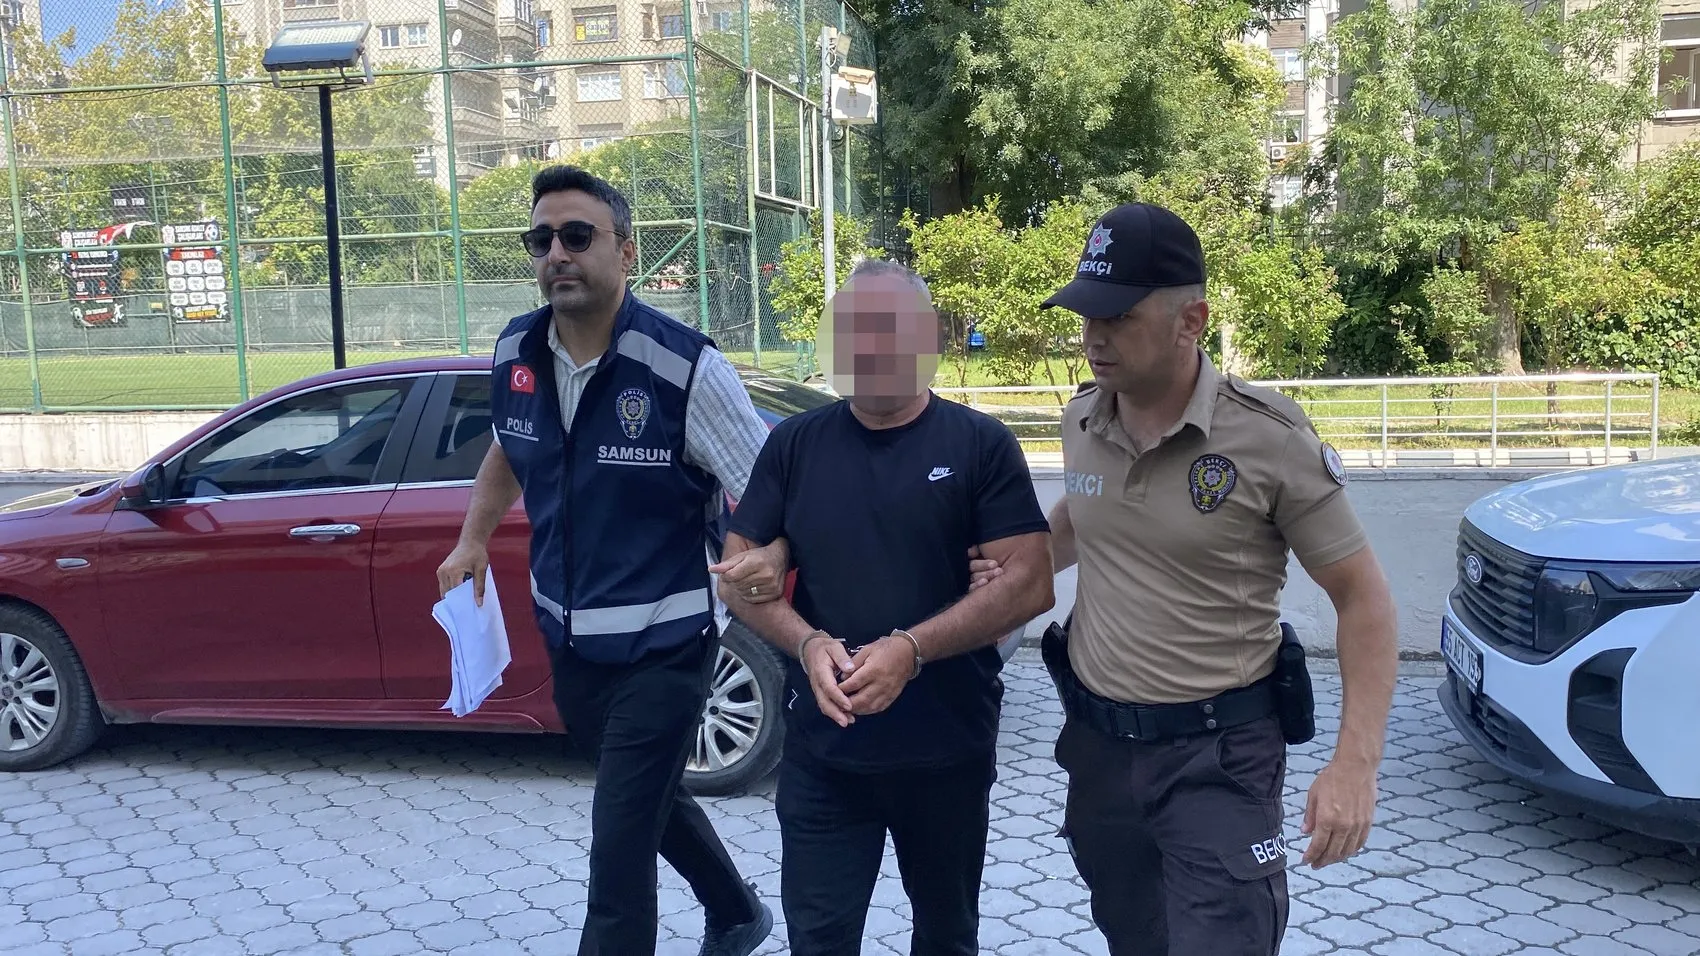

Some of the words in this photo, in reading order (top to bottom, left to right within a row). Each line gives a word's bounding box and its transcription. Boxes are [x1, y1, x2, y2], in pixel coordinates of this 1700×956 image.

[507, 417, 533, 435] POLİS
[598, 445, 671, 462] SAMSUN
[931, 467, 950, 475] NIKE
